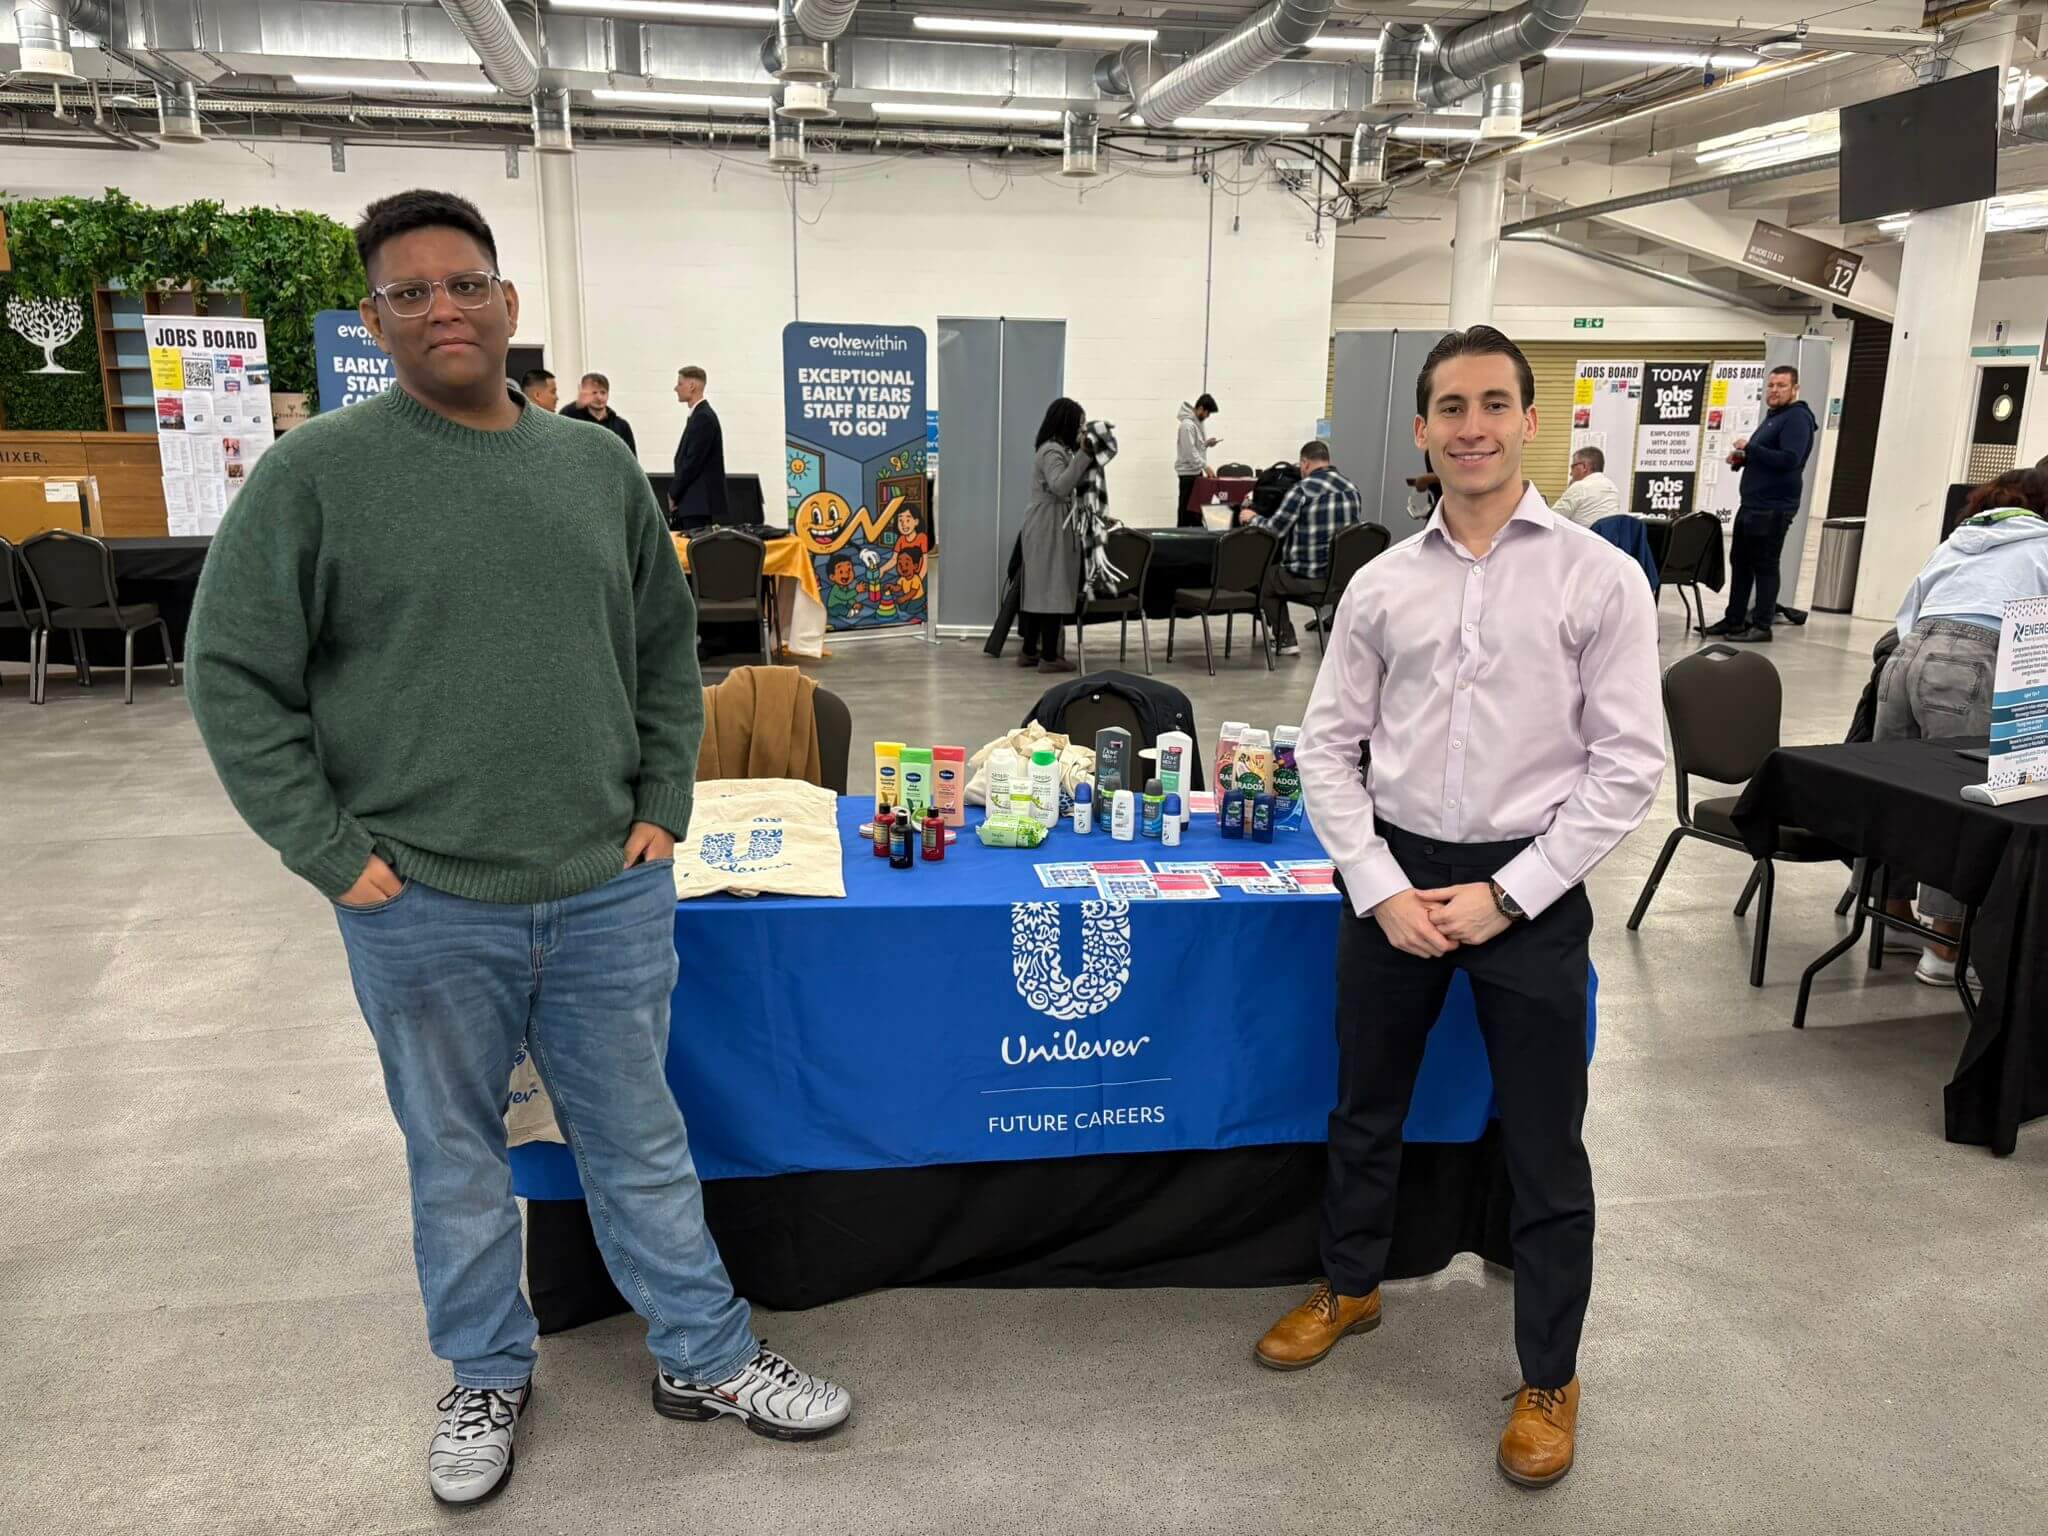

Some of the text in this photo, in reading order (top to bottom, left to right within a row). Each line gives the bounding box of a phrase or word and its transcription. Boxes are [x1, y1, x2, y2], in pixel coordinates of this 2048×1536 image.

[1828, 266, 1853, 292] 12
[155, 328, 257, 349] JOBS BOARD
[809, 332, 907, 351] evolvewithin
[333, 356, 389, 374] EARLY
[1580, 366, 1639, 378] JOBS BOARD
[1716, 367, 1738, 379] JOBS
[798, 368, 914, 385] EXCEPTIONAL
[1651, 368, 1704, 382] TODAY
[802, 386, 911, 403] EARLY YEARS
[1654, 385, 1694, 408] Jobs
[803, 403, 911, 420] STAFF READY
[1659, 401, 1693, 419] fair
[829, 421, 887, 436] TO GO!
[1646, 476, 1684, 498] Jobs
[1651, 492, 1683, 510] fair
[1001, 1028, 1151, 1065] Unilever
[508, 1089, 539, 1104] er
[988, 1105, 1166, 1133] FUTURE CAREERS
